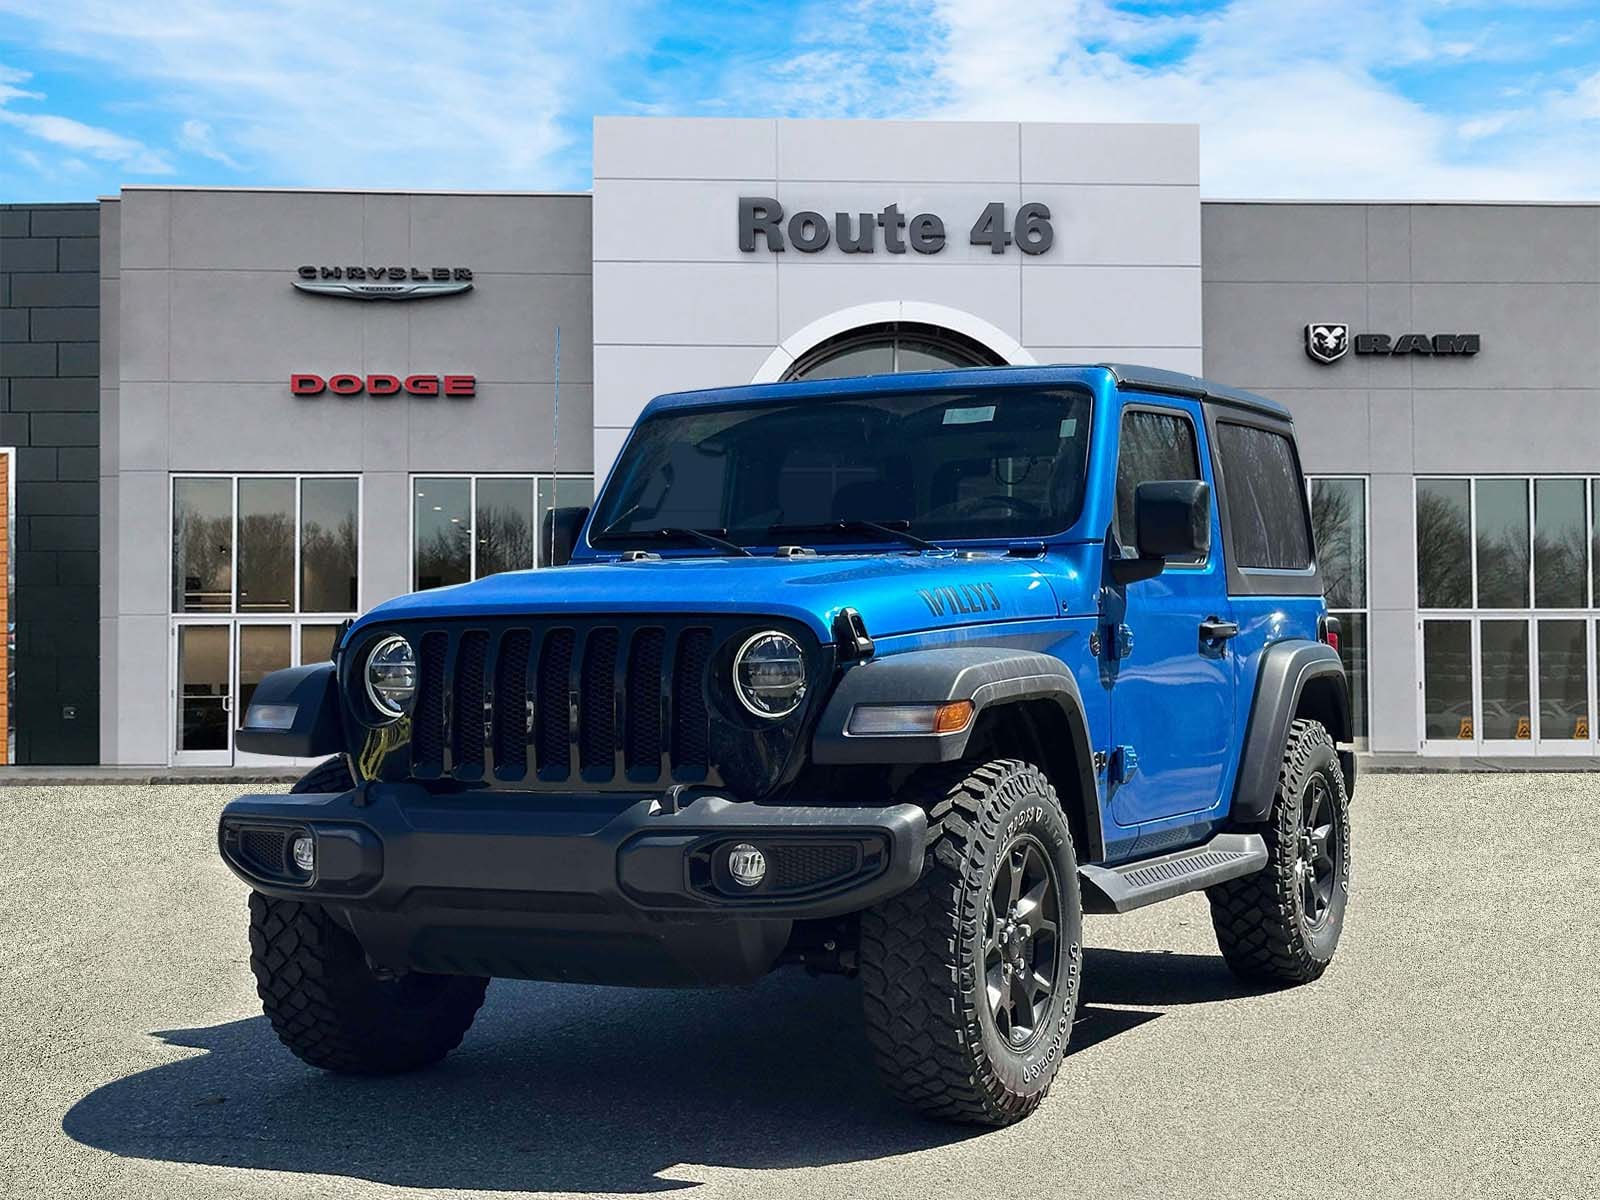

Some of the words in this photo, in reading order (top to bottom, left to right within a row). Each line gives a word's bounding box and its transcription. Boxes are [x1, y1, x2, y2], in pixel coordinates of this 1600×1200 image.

[738, 197, 946, 255] Route
[970, 201, 1054, 255] 46
[298, 265, 474, 281] CHRYSLER
[1354, 334, 1480, 356] RAM
[290, 374, 477, 397] DODGE
[916, 582, 1001, 617] WILLYS
